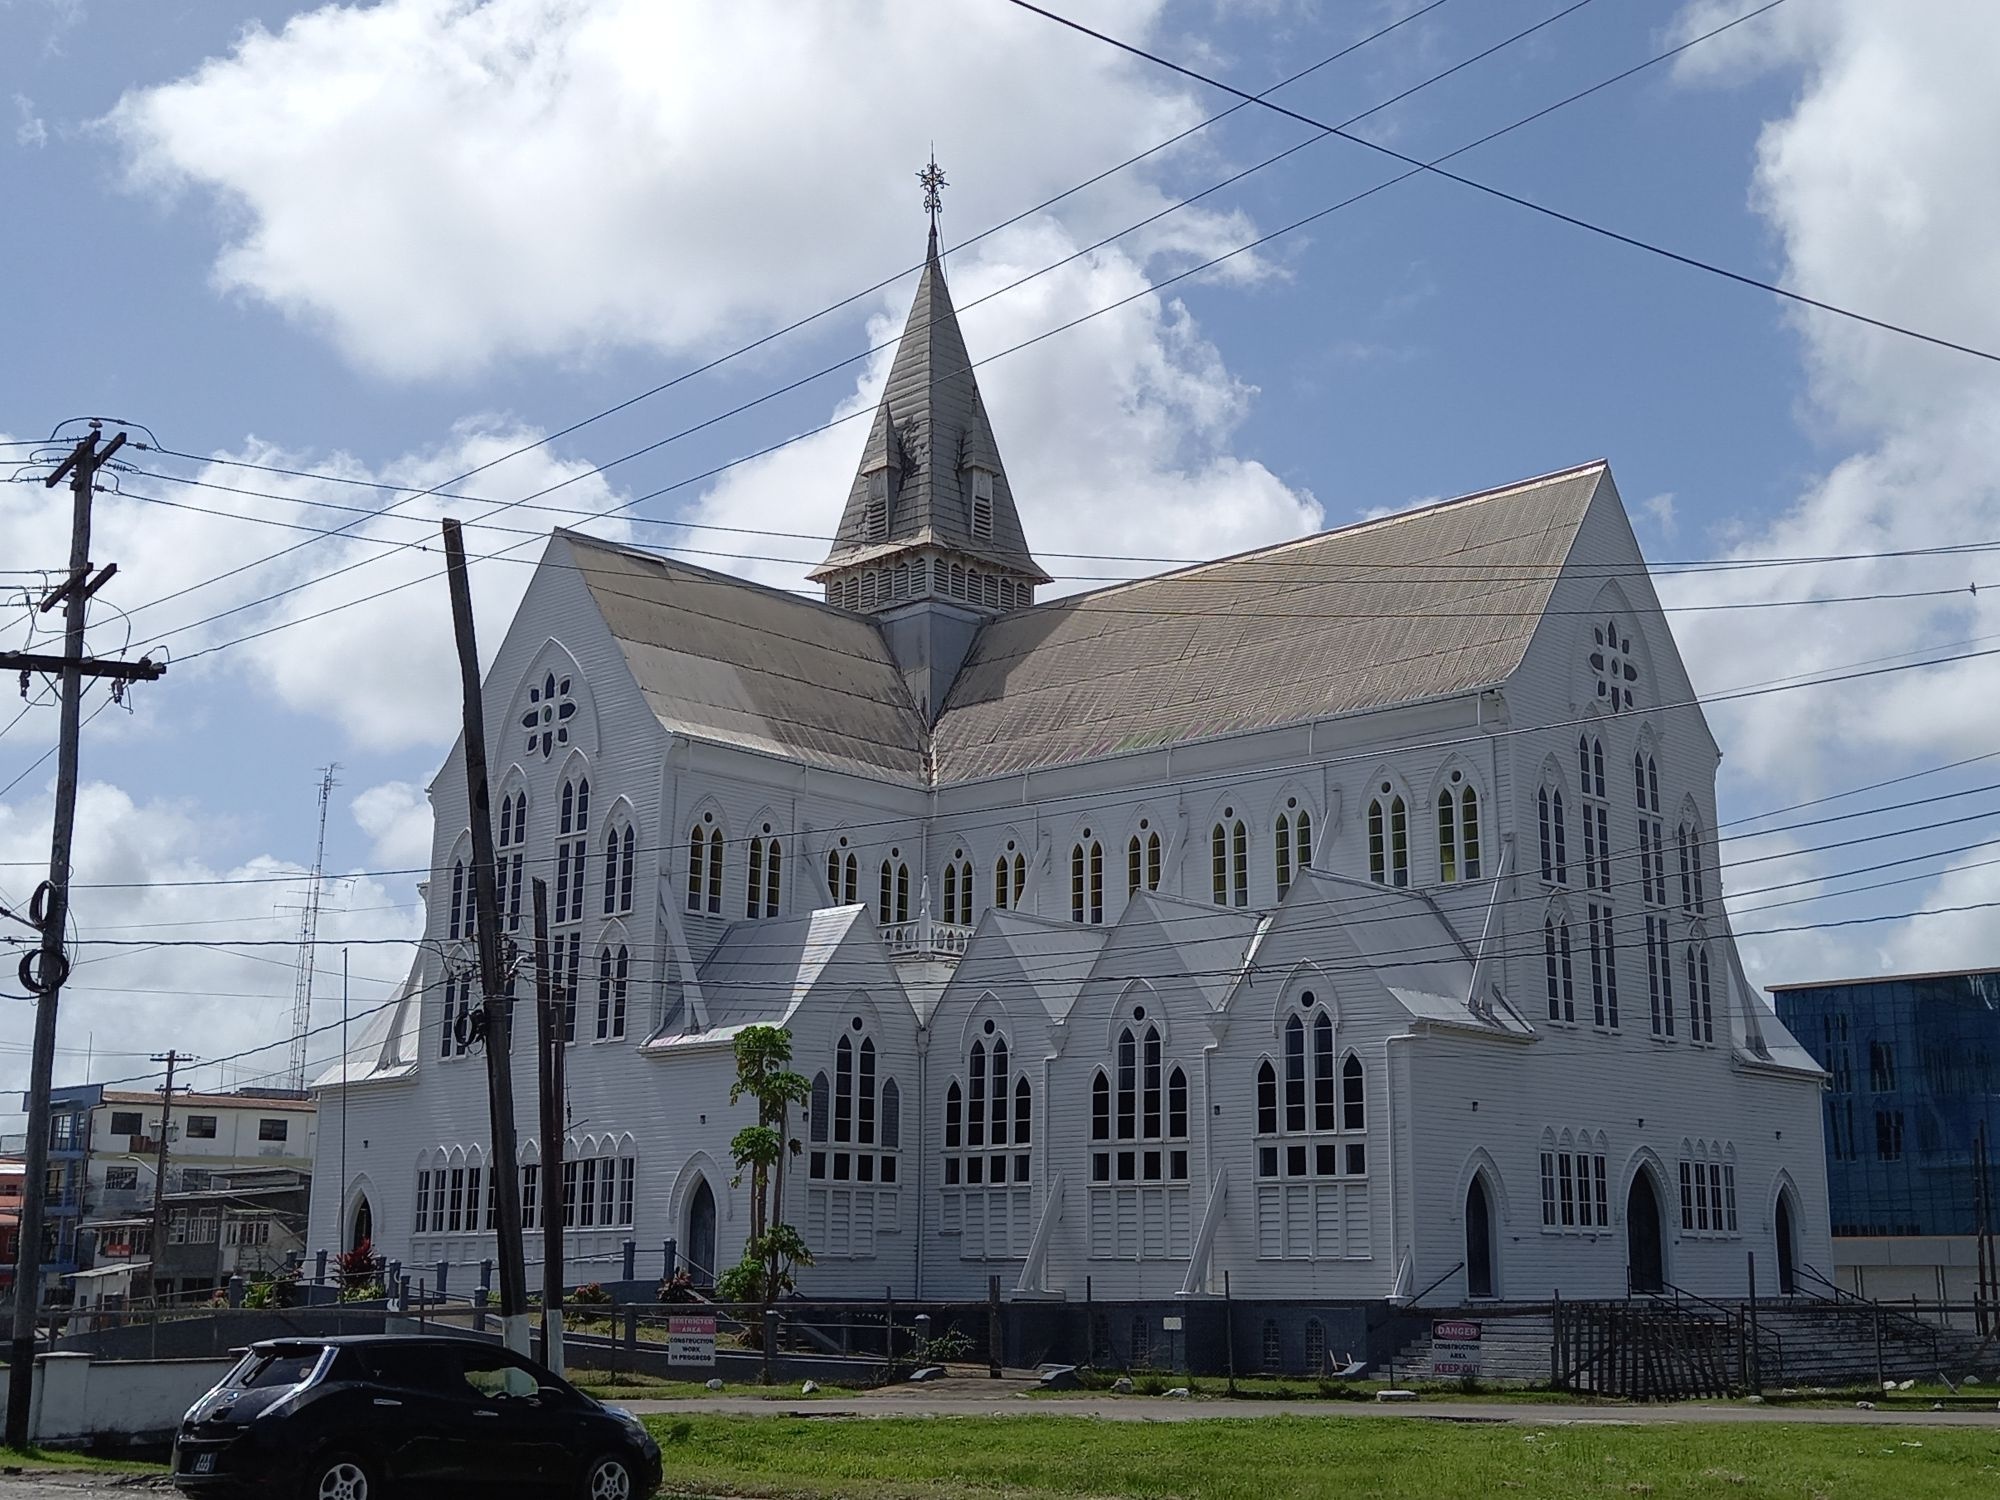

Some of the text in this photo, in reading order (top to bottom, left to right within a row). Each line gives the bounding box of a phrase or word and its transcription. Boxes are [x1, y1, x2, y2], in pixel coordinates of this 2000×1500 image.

[1438, 1326, 1477, 1336] DANGER
[1434, 1343, 1480, 1351] CONSTRUCTION
[1435, 1363, 1481, 1373] KEEP OUT
